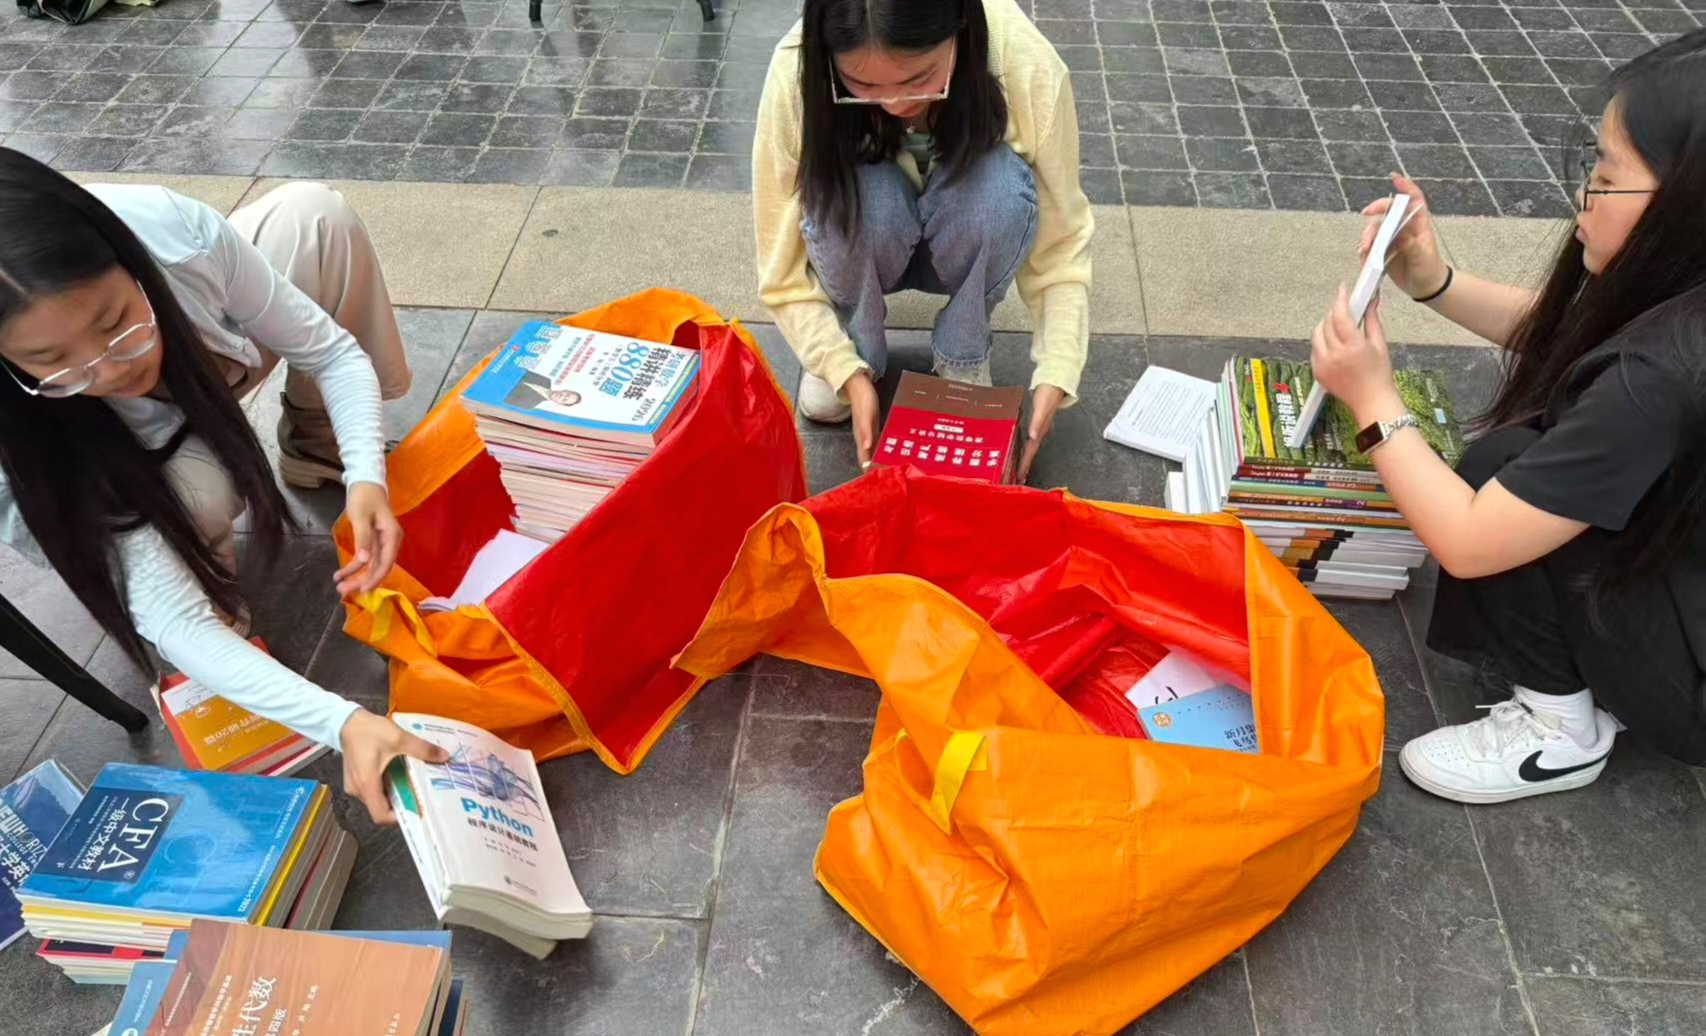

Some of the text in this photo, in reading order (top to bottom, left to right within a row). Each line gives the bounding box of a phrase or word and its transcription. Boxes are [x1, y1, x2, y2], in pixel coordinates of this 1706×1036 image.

[598, 341, 650, 397] 880题
[622, 346, 672, 401] 精讲精练
[12, 827, 48, 859] HORIZ
[77, 796, 132, 873] 一级中文教材
[96, 796, 169, 874] CFA
[460, 796, 534, 838] Python
[0, 835, 30, 887] 大学英
